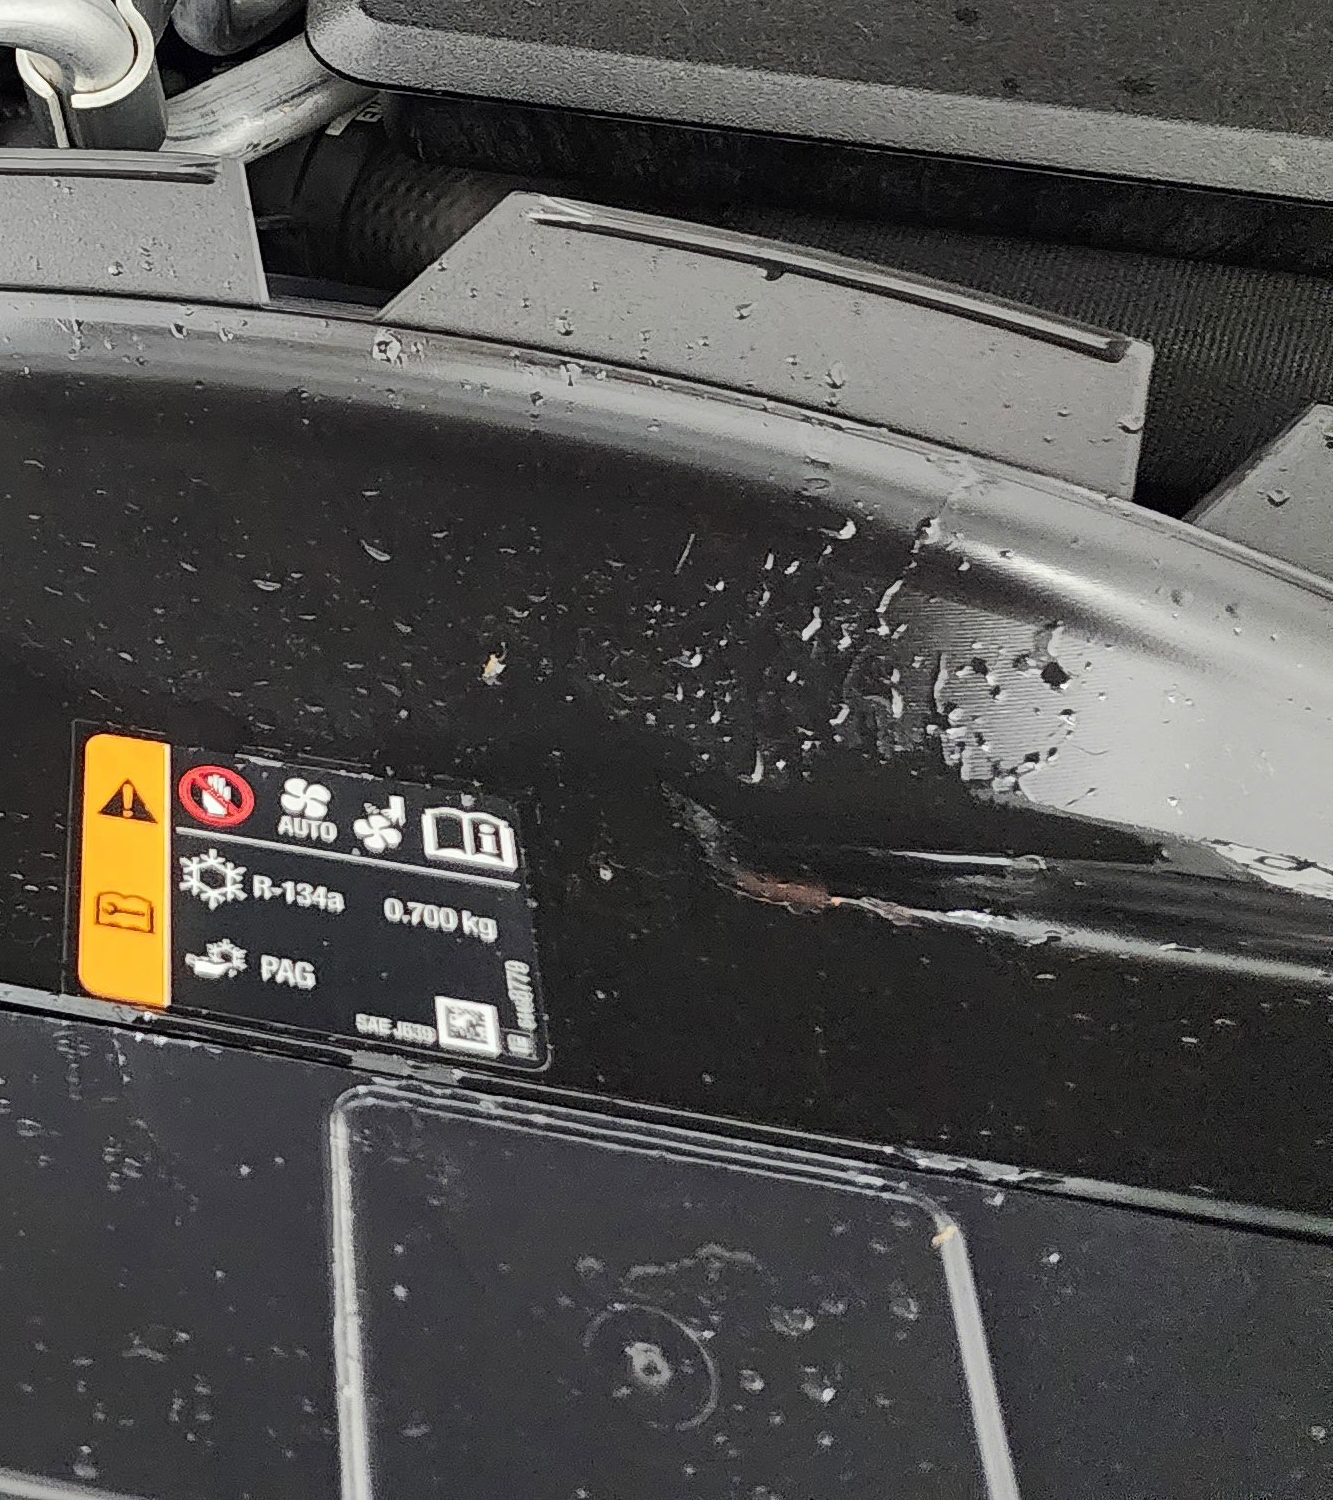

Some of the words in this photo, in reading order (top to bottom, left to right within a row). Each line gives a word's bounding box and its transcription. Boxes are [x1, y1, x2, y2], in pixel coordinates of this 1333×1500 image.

[276, 814, 338, 843] AUTO
[252, 874, 345, 914] R-134a
[383, 896, 457, 933] 0.700
[462, 909, 499, 944] kg
[260, 953, 318, 991] PAG
[355, 1012, 392, 1036] SAE
